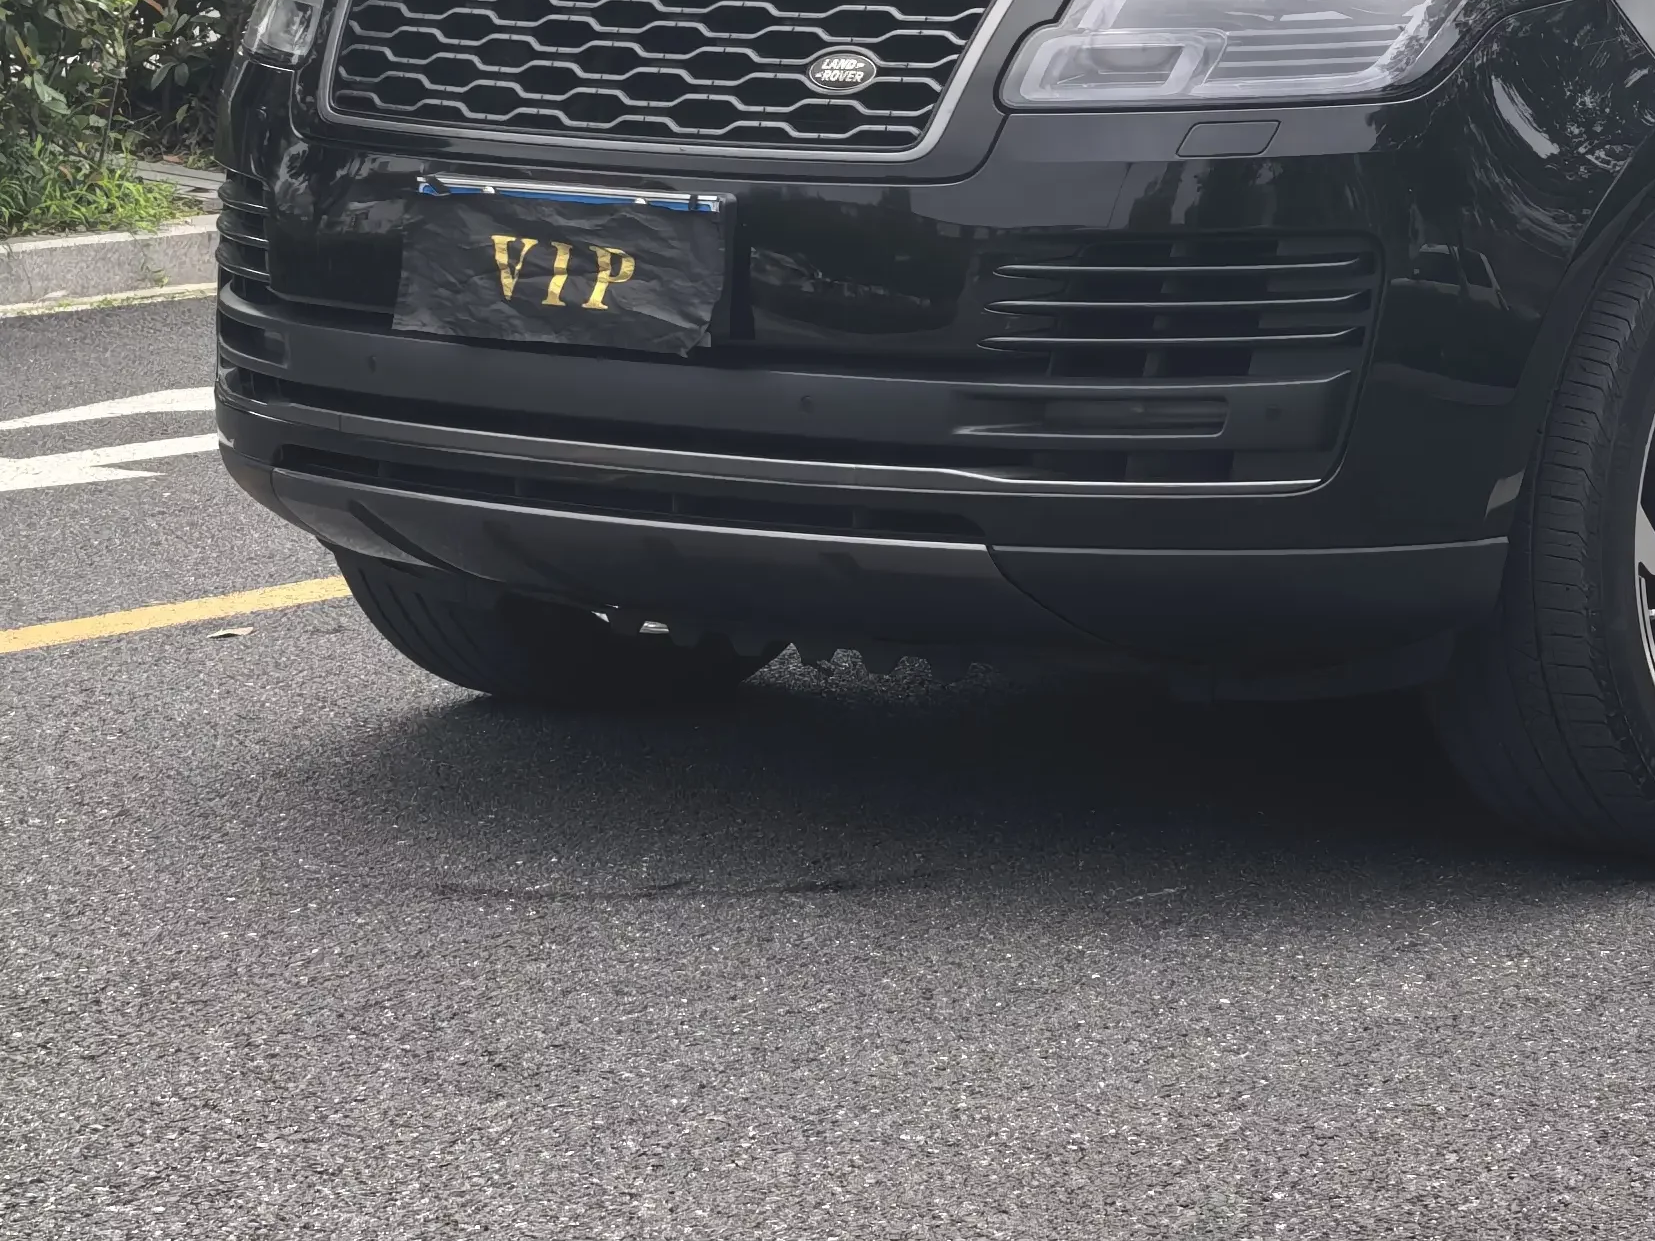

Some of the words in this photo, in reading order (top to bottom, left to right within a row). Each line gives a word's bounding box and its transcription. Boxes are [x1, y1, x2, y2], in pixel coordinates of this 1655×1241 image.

[821, 58, 858, 70] LAND
[821, 70, 865, 82] ROVER
[490, 234, 636, 310] VIP
